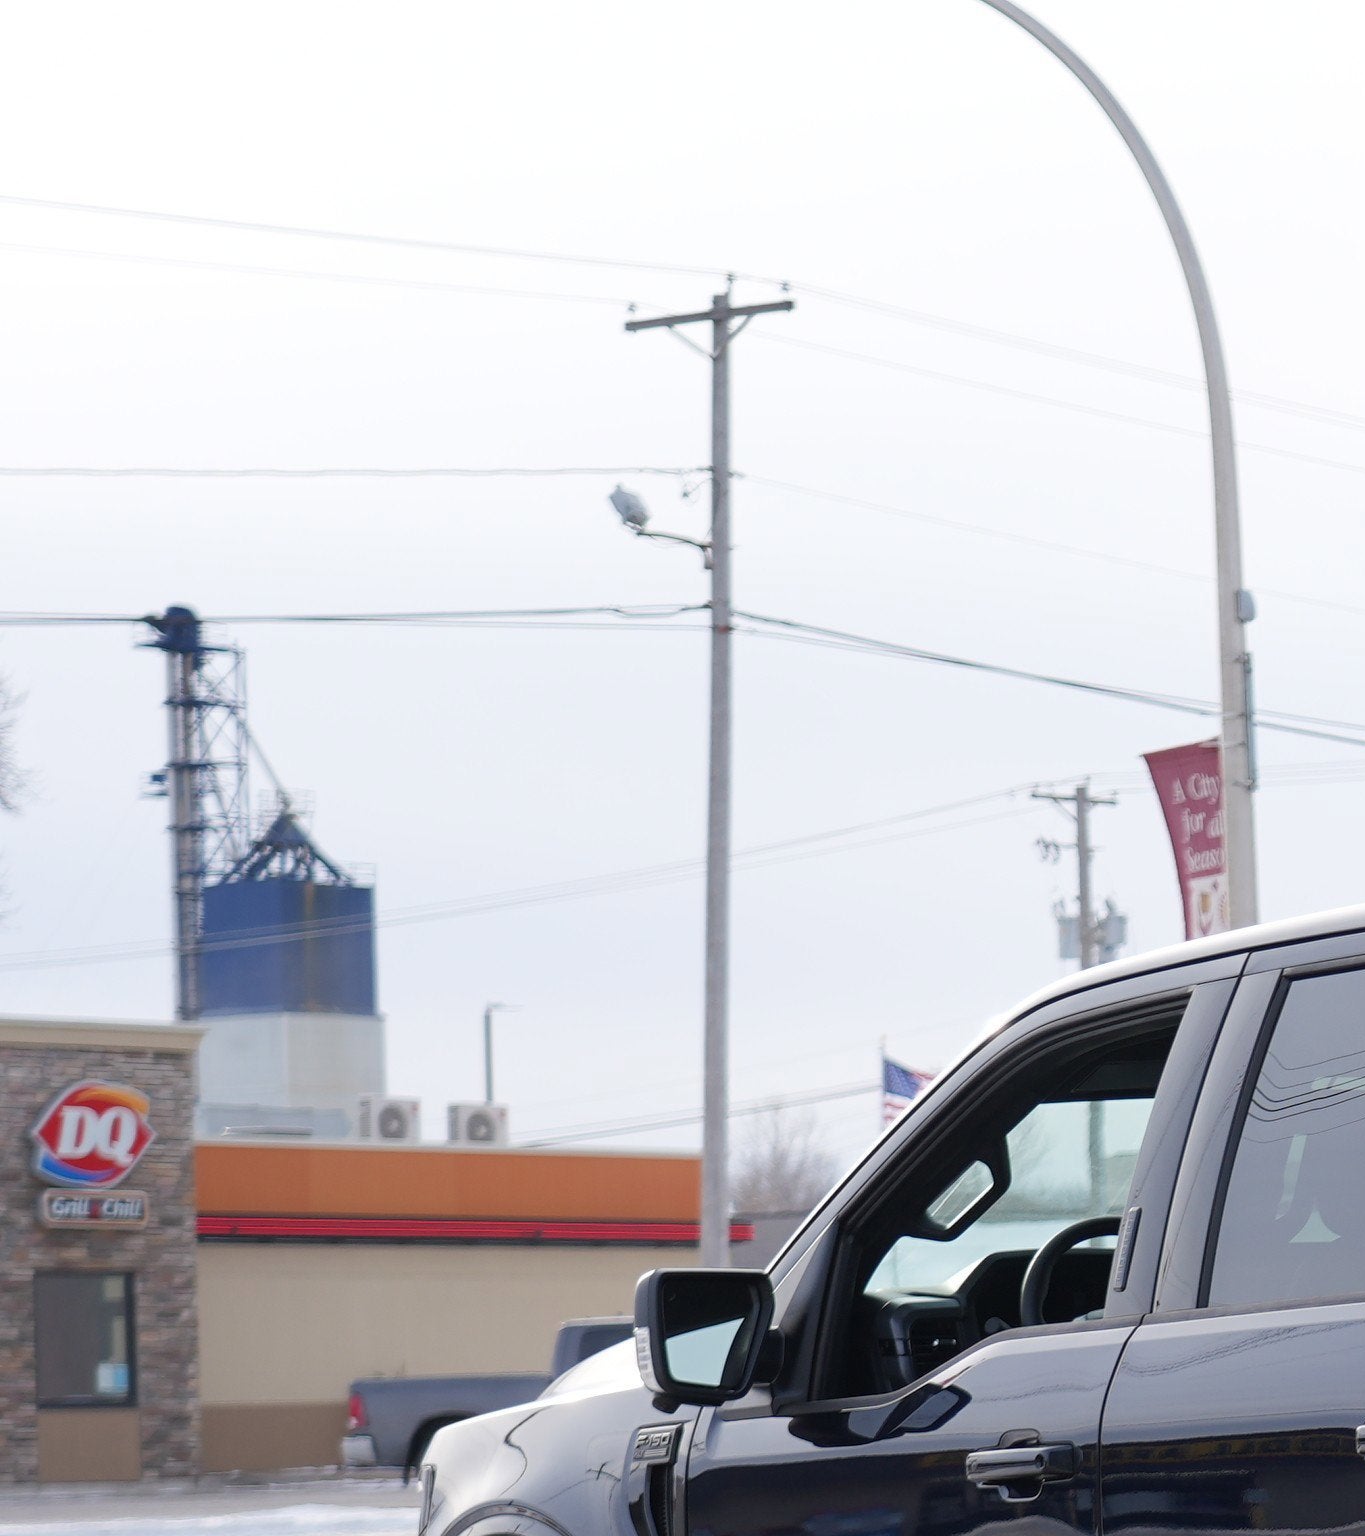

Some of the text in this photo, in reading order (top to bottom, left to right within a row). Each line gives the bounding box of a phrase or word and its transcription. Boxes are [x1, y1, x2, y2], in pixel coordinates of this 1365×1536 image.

[1180, 807, 1207, 843] for
[1184, 846, 1226, 873] Seaso
[56, 1105, 136, 1168] DQ
[52, 1197, 90, 1216] Grill
[102, 1198, 142, 1217] Chill
